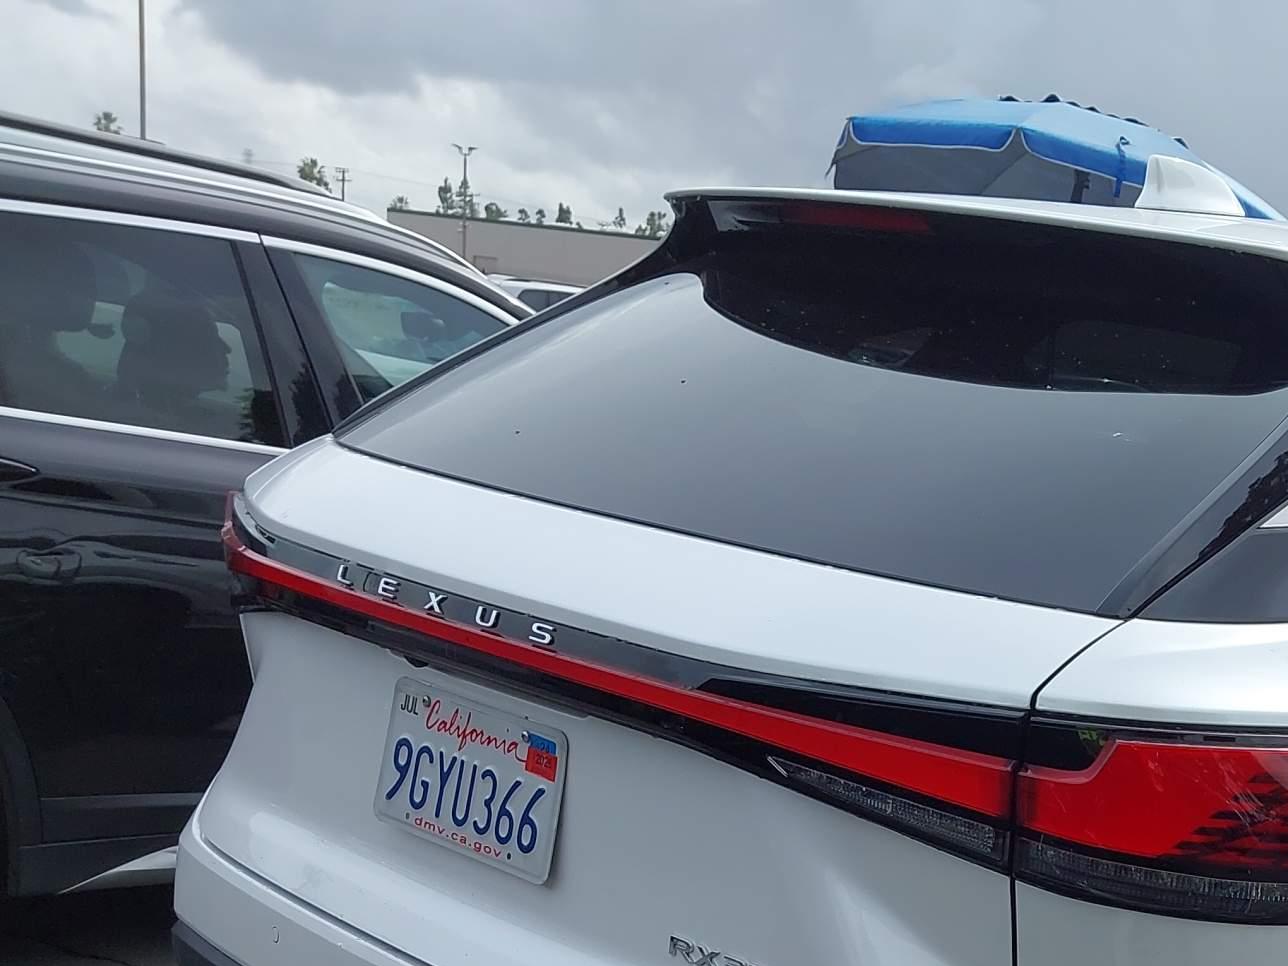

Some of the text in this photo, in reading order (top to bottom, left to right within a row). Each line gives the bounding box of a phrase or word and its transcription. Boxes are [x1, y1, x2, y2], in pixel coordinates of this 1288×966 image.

[336, 564, 557, 646] LEXUS
[401, 694, 418, 716] JUL
[424, 700, 526, 762] California
[385, 737, 546, 854] 9GYU366
[414, 816, 502, 858] dmv.ca.gov
